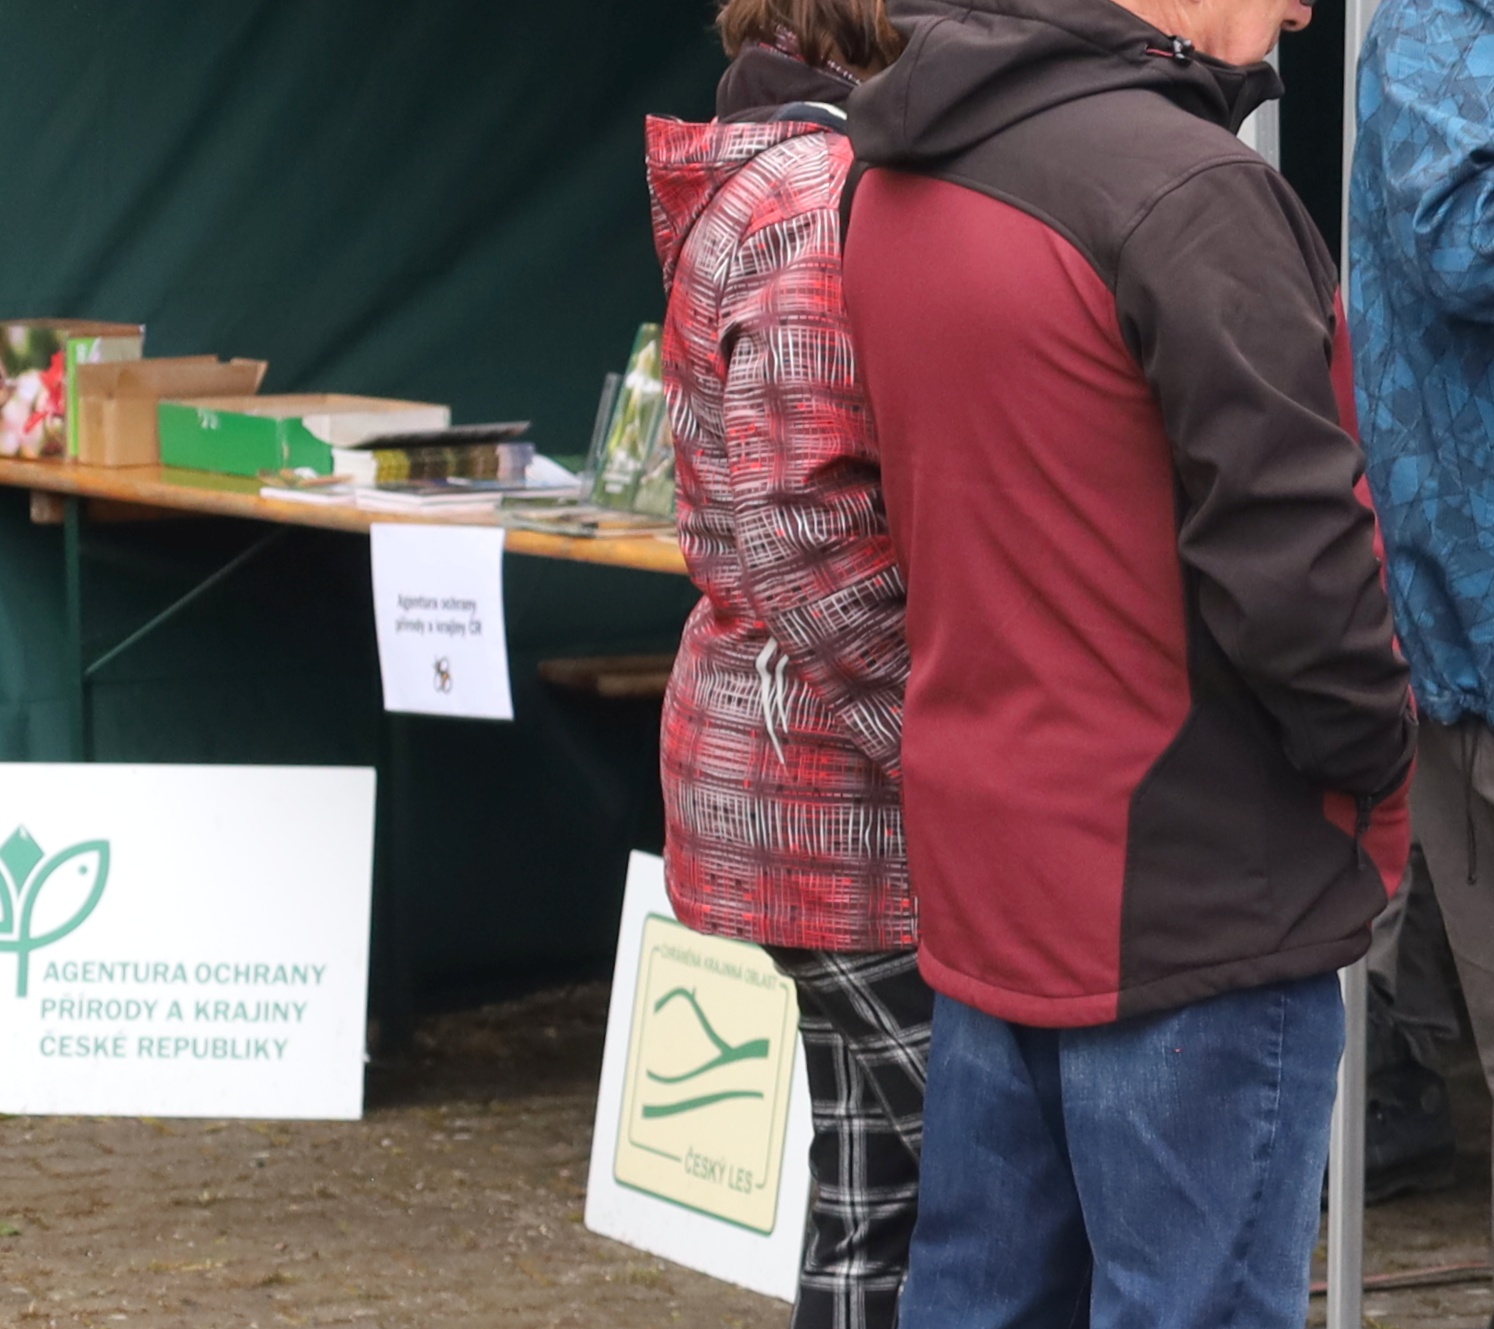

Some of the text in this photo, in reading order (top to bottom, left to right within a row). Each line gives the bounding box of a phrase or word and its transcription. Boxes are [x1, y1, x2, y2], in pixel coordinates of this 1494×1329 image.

[43, 960, 327, 985] AGENTURA OCHRANY
[40, 991, 307, 1022] PŘÍRODY A KRAJINY
[39, 1029, 288, 1060] ČESKÉ REPUBLIKY
[684, 1145, 753, 1194] ČESKÝ LES
